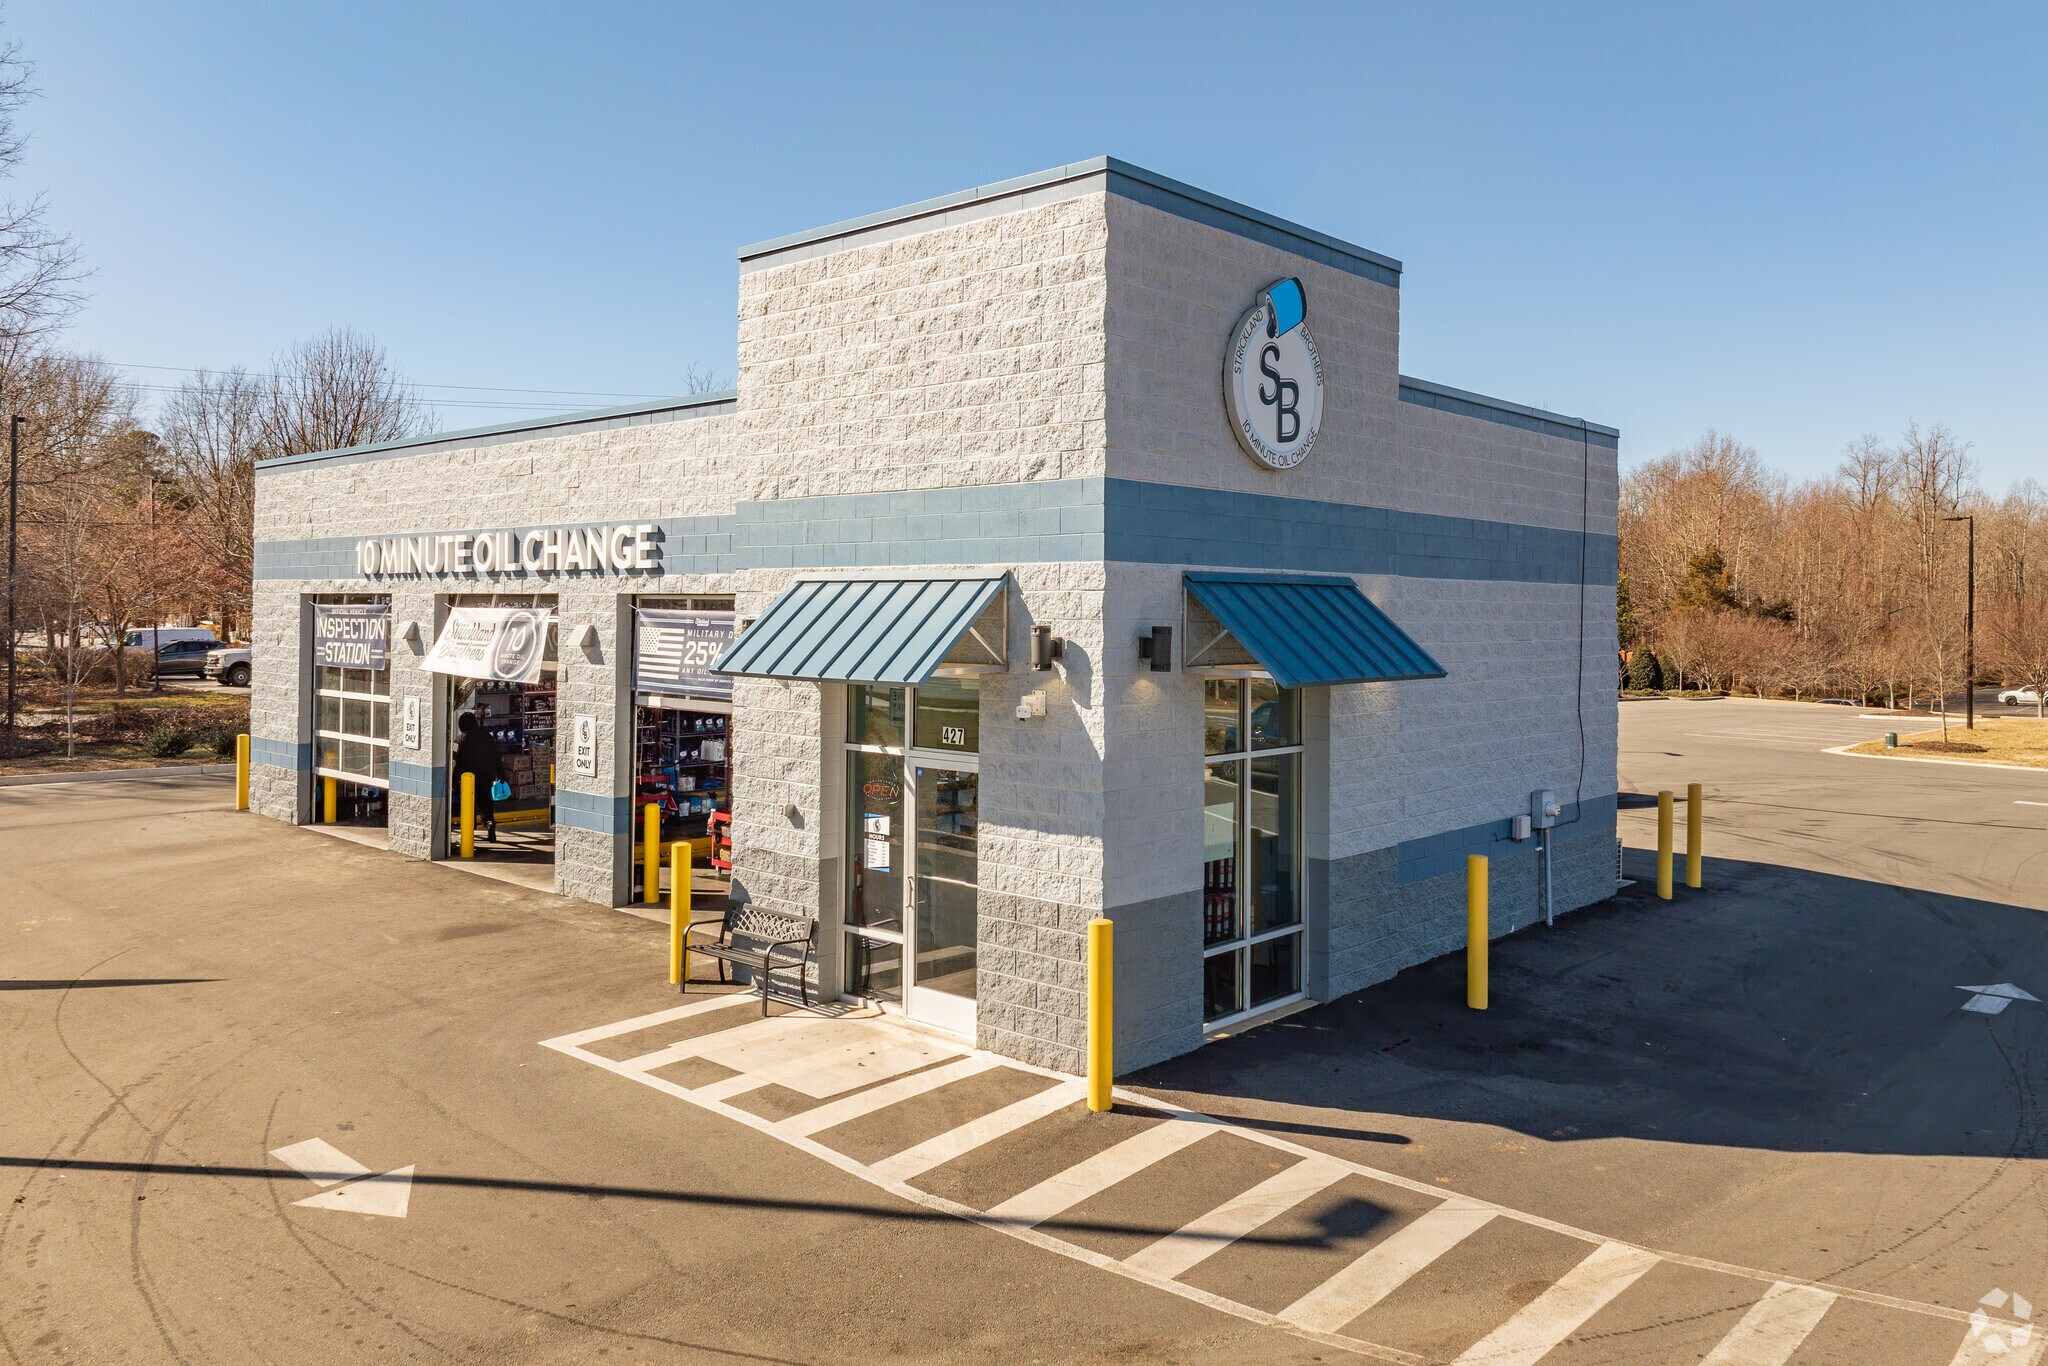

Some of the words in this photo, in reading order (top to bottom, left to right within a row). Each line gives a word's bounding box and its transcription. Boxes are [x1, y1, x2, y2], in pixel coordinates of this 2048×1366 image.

[1234, 310, 1264, 374] STRICKLAND
[1300, 326, 1323, 386] BROTHERS
[1242, 419, 1251, 433] 10
[1249, 433, 1277, 465] MINUTE
[1278, 455, 1290, 467] OIL
[1291, 426, 1317, 464] CHANGE
[356, 539, 381, 575] 10
[380, 534, 473, 575] MINUTE
[472, 530, 523, 573] OIL
[523, 524, 659, 572] CHANGE
[316, 617, 386, 640] INSPECTION
[445, 619, 496, 642] Strickland
[506, 626, 527, 652] 10
[687, 629, 725, 638] MILITARY
[325, 641, 371, 665] STATION
[438, 640, 485, 661] Brothers
[683, 641, 724, 666] 25%
[405, 733, 416, 743] ONLY
[943, 727, 964, 745] 427
[578, 745, 591, 756] EXIT
[577, 758, 592, 769] ONLY
[863, 783, 899, 797] OPEN
[868, 833, 885, 841] HOURS
